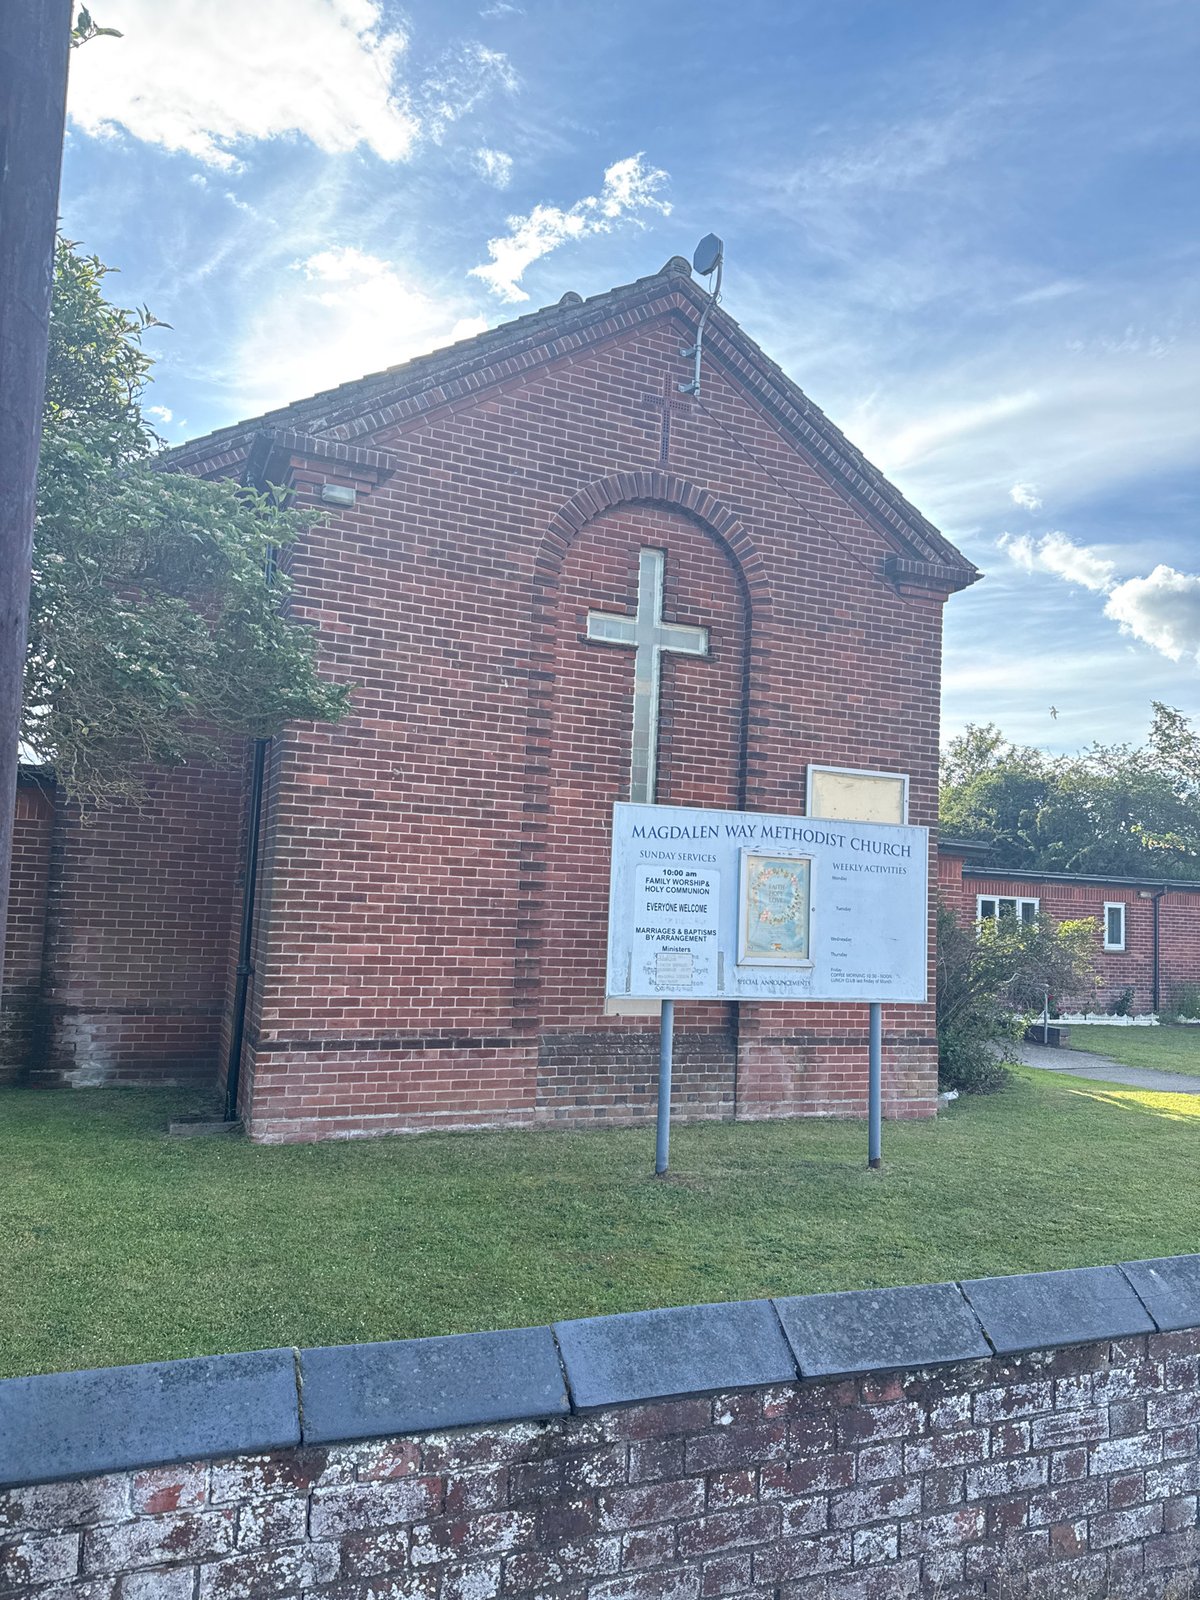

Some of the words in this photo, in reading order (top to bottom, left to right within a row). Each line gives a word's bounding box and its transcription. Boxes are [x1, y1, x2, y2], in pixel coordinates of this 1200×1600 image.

[631, 825, 719, 839] MAGDALEN
[725, 825, 756, 838] WAY
[761, 825, 846, 848] METHODIST
[850, 838, 911, 858] CHURCH
[639, 850, 675, 860] SUNDAY
[678, 853, 717, 863] SERVICES
[662, 869, 684, 877] 10:00
[832, 862, 863, 872] WEEKLY
[864, 865, 907, 875] ACTIVITIES
[645, 877, 671, 885] FAMILY
[645, 886, 665, 894] HOLY
[666, 887, 710, 895] COMMUNION
[646, 902, 678, 912] EVERYONE
[679, 903, 708, 913] WELCOME
[636, 927, 676, 935] MARRIAGES
[684, 928, 717, 936] BAPTISMS
[656, 934, 707, 942] ARRANGEMENT
